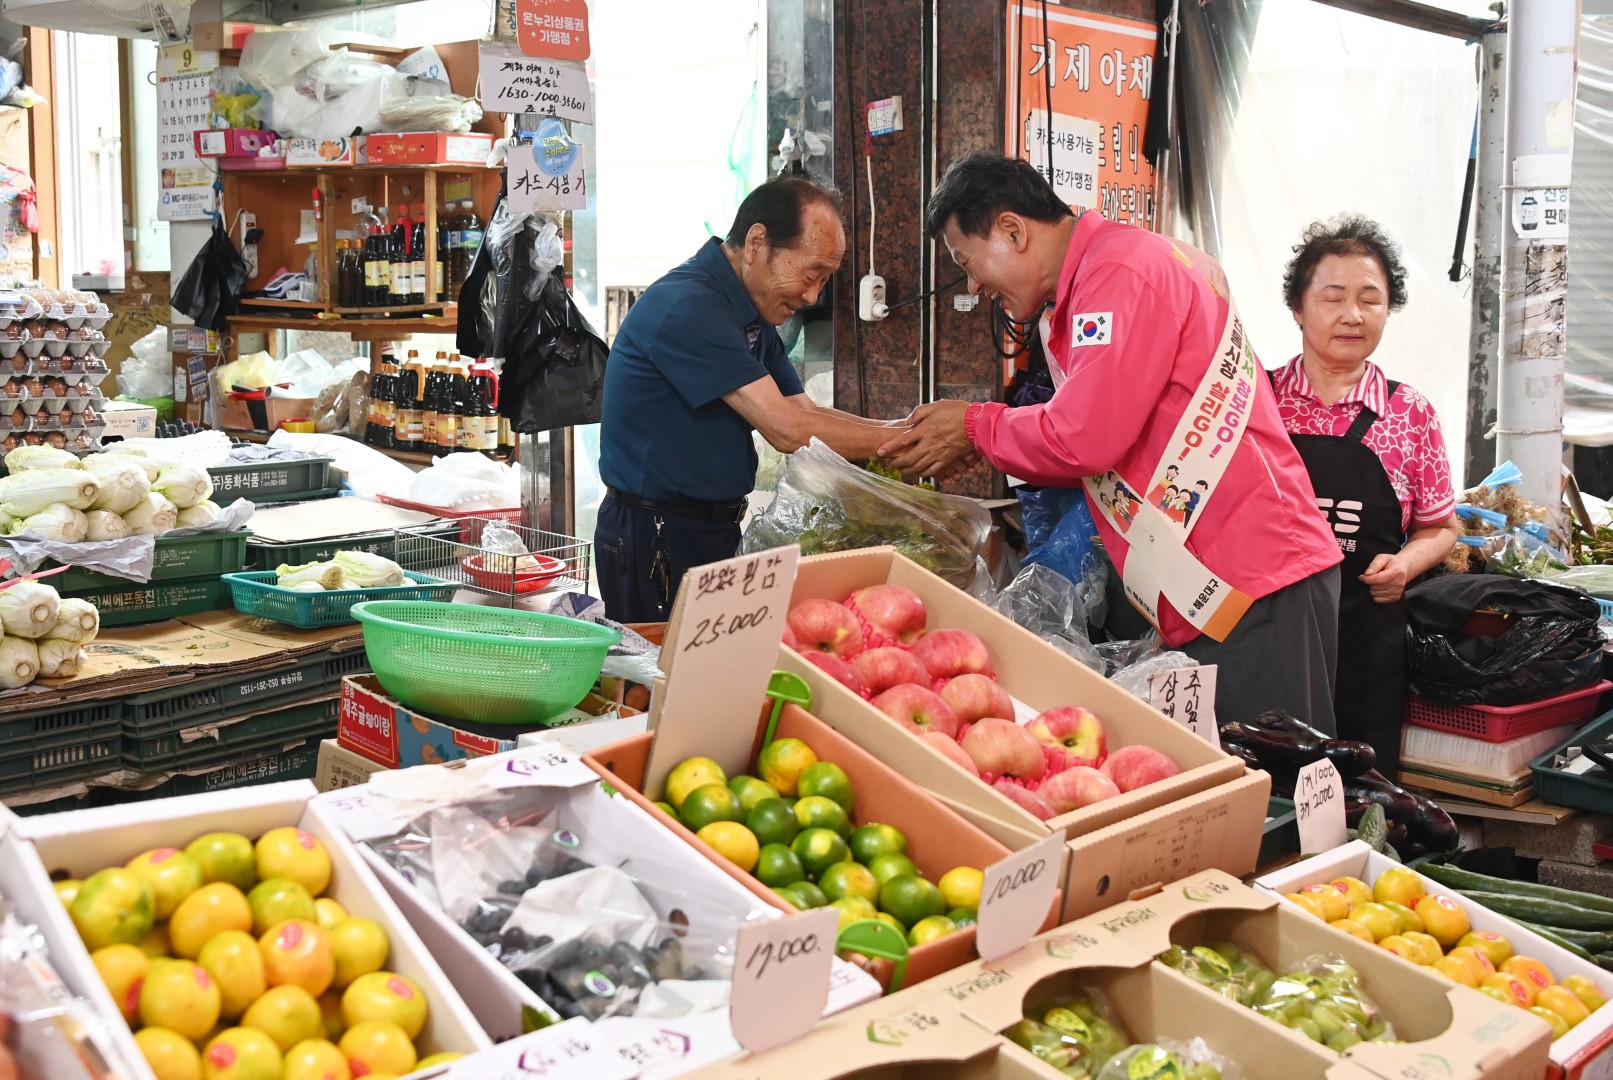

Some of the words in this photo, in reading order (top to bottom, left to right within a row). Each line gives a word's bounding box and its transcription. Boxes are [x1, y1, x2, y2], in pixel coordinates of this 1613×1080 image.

[522, 12, 585, 31] 온누리상품권
[540, 30, 571, 46] 가맹점
[183, 49, 192, 68] 9
[1028, 37, 1091, 92] 거제
[1099, 48, 1153, 100] 야채
[178, 82, 183, 91] 2
[186, 80, 190, 90] 3
[193, 80, 198, 88] 4
[200, 79, 205, 88] 5
[185, 98, 192, 107] 10
[193, 97, 199, 106] 11
[170, 116, 177, 125] 15
[170, 134, 177, 143] 22
[170, 151, 178, 160] 29
[178, 150, 185, 160] 30
[513, 169, 544, 196] 카드
[1192, 578, 1220, 611] 해운대구
[1312, 784, 1335, 809] 2000
